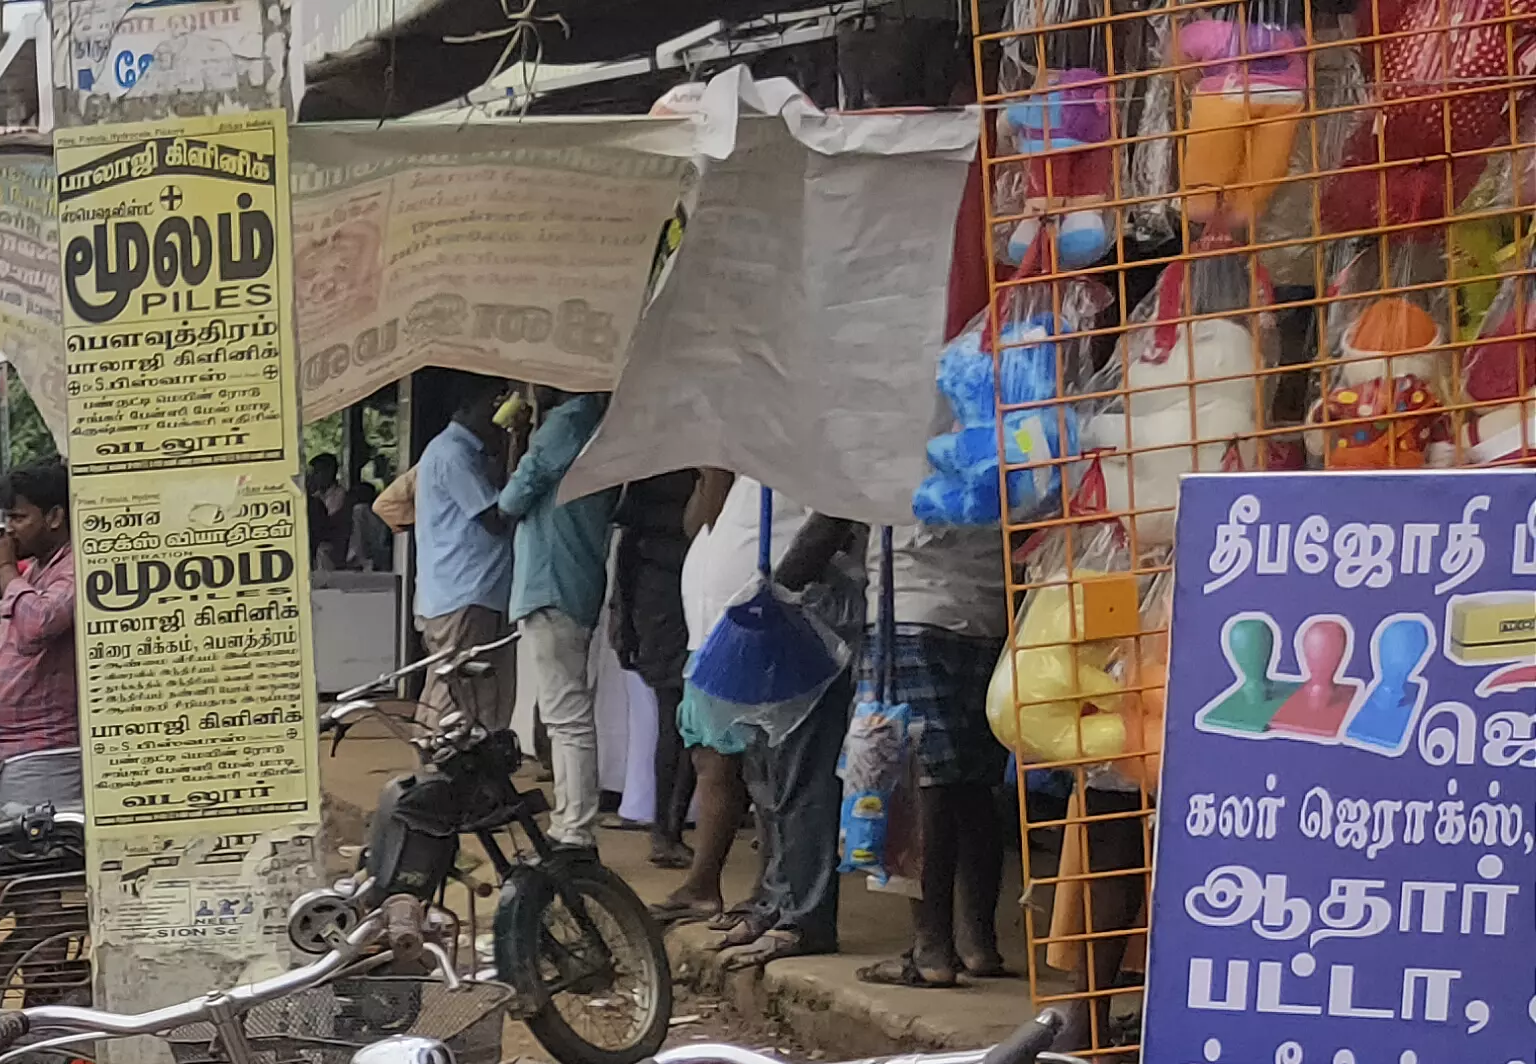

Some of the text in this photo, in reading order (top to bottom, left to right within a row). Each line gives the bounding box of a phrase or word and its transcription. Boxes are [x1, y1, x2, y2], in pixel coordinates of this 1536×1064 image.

[61, 140, 159, 193] பாலாஜி
[164, 137, 270, 181] கிளினிக்
[65, 192, 274, 324] மூலம்
[141, 283, 272, 316] PILES
[67, 341, 280, 376] பாலாஜி கிளினிக்
[96, 427, 250, 457] வடலூர்
[82, 531, 160, 555] செக்ஸ்
[1203, 493, 1491, 595] தீபஜோதி
[86, 544, 294, 612] மூலம்
[158, 587, 292, 604] PILES
[87, 597, 300, 636] பாலாஜி கிளினிக்
[91, 704, 304, 738] பாலாஜி கிளினிக்
[121, 780, 275, 808] வடலூர்
[1186, 775, 1536, 859] கலர் ஜெராக்ஸ்,
[1184, 854, 1521, 950] ஆதார்
[1187, 953, 1490, 1033] பட்டா,
